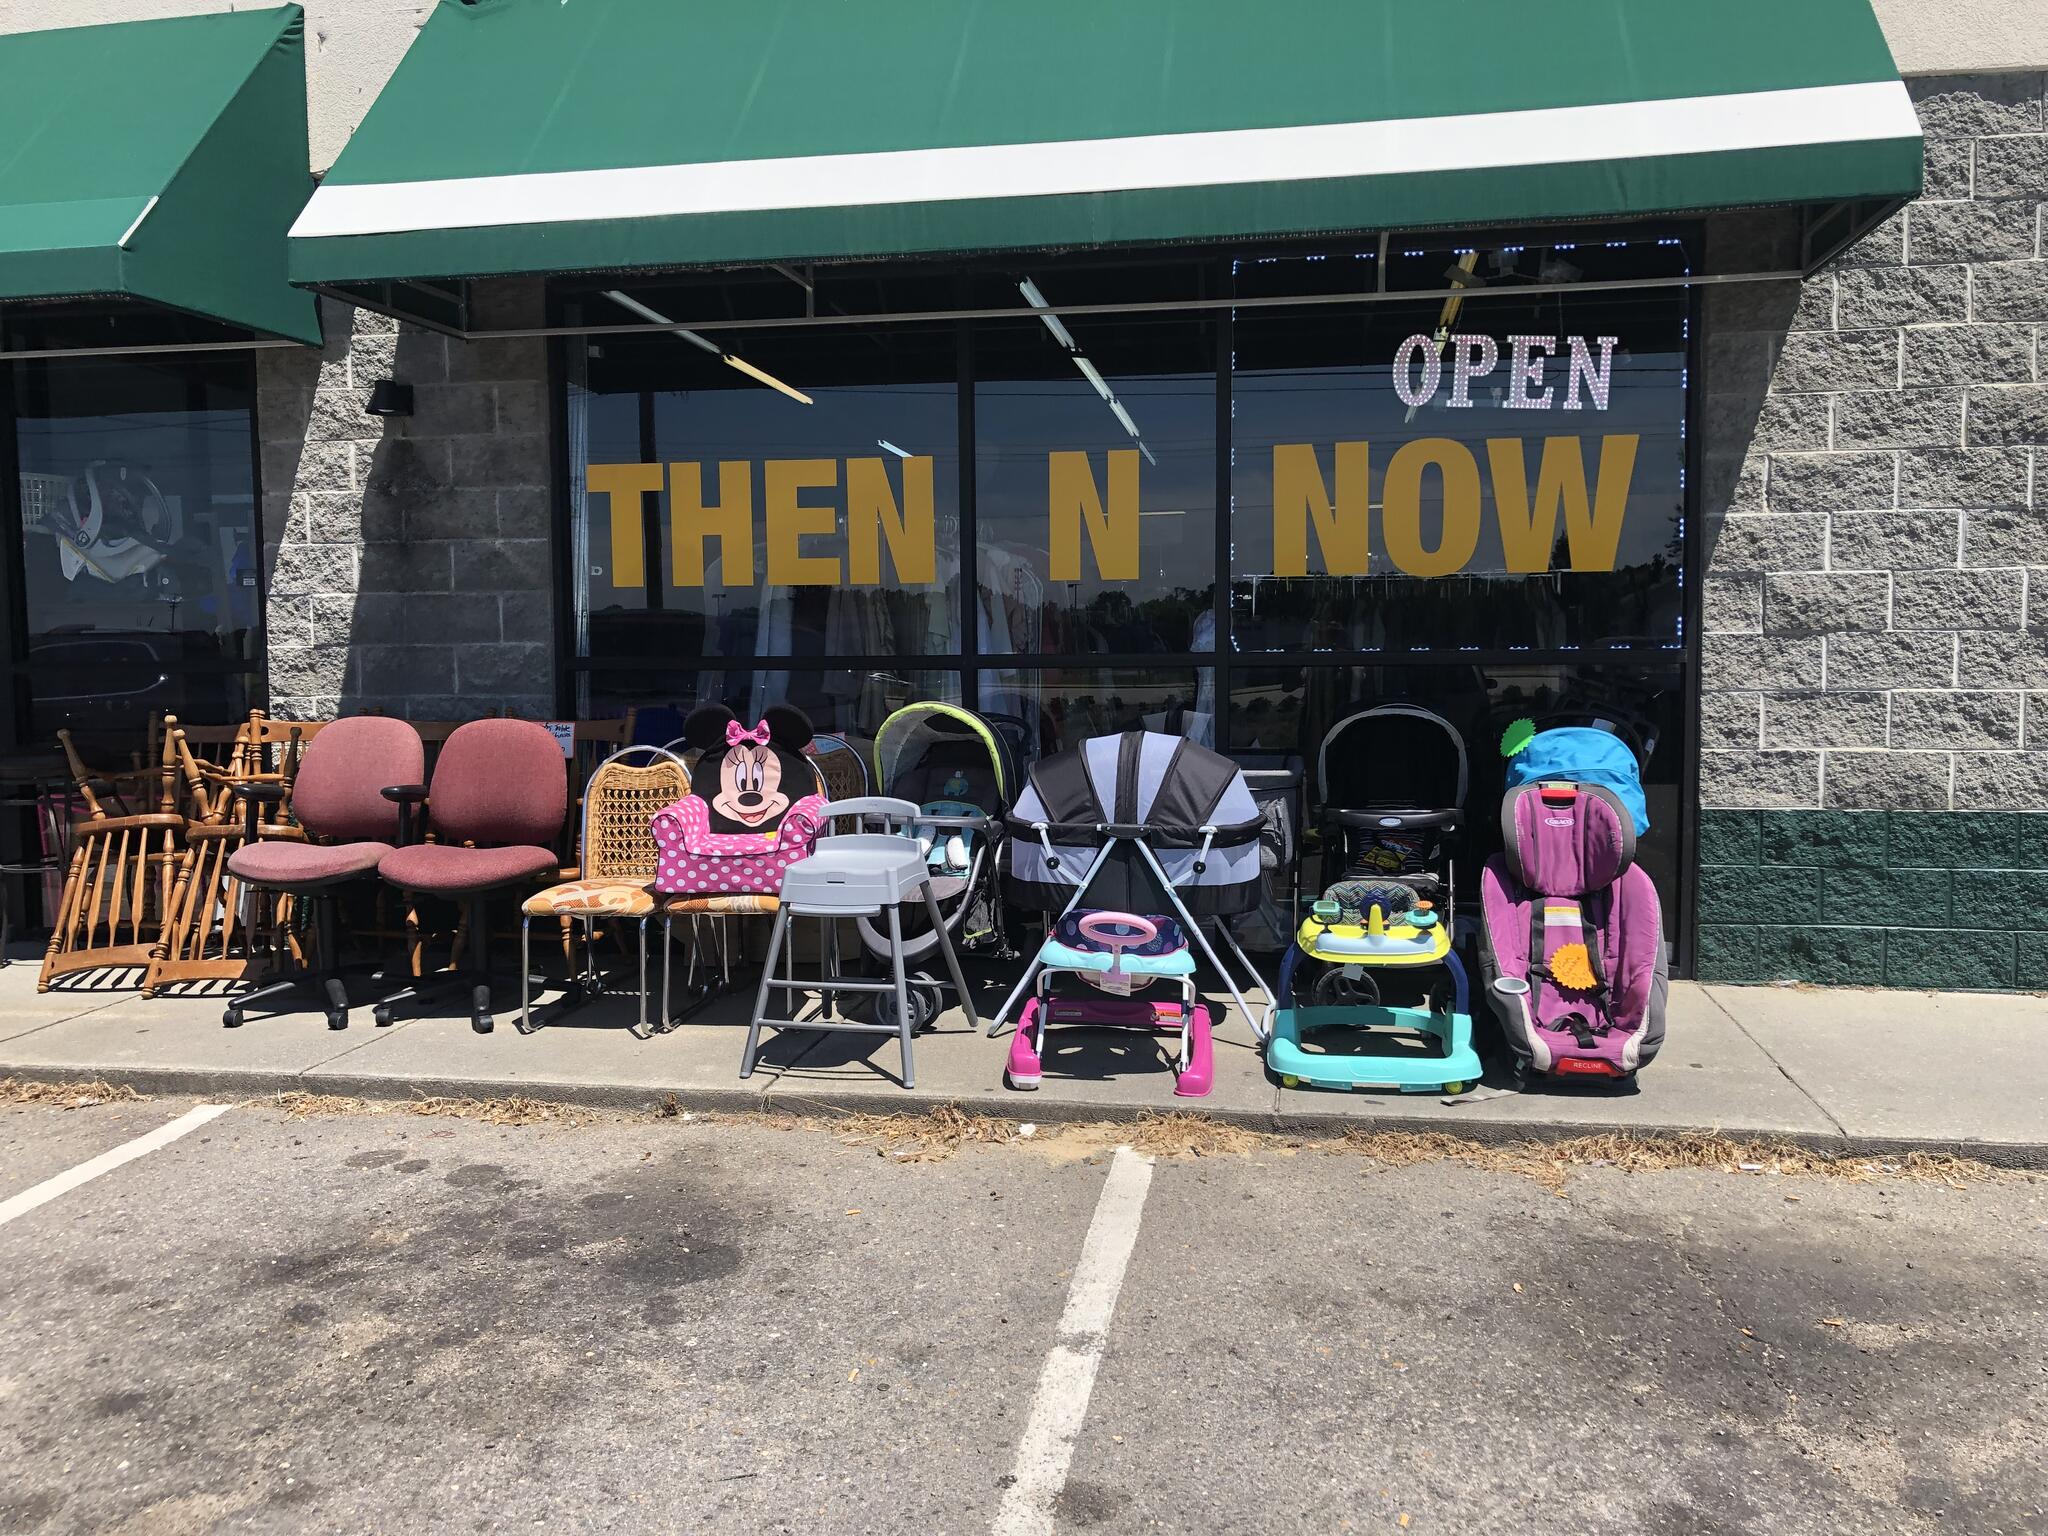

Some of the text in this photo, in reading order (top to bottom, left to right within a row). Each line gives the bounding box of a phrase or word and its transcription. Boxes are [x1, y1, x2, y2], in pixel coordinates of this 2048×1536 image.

[1392, 333, 1619, 411] OPEN
[587, 434, 1640, 588] THEN N NOW
